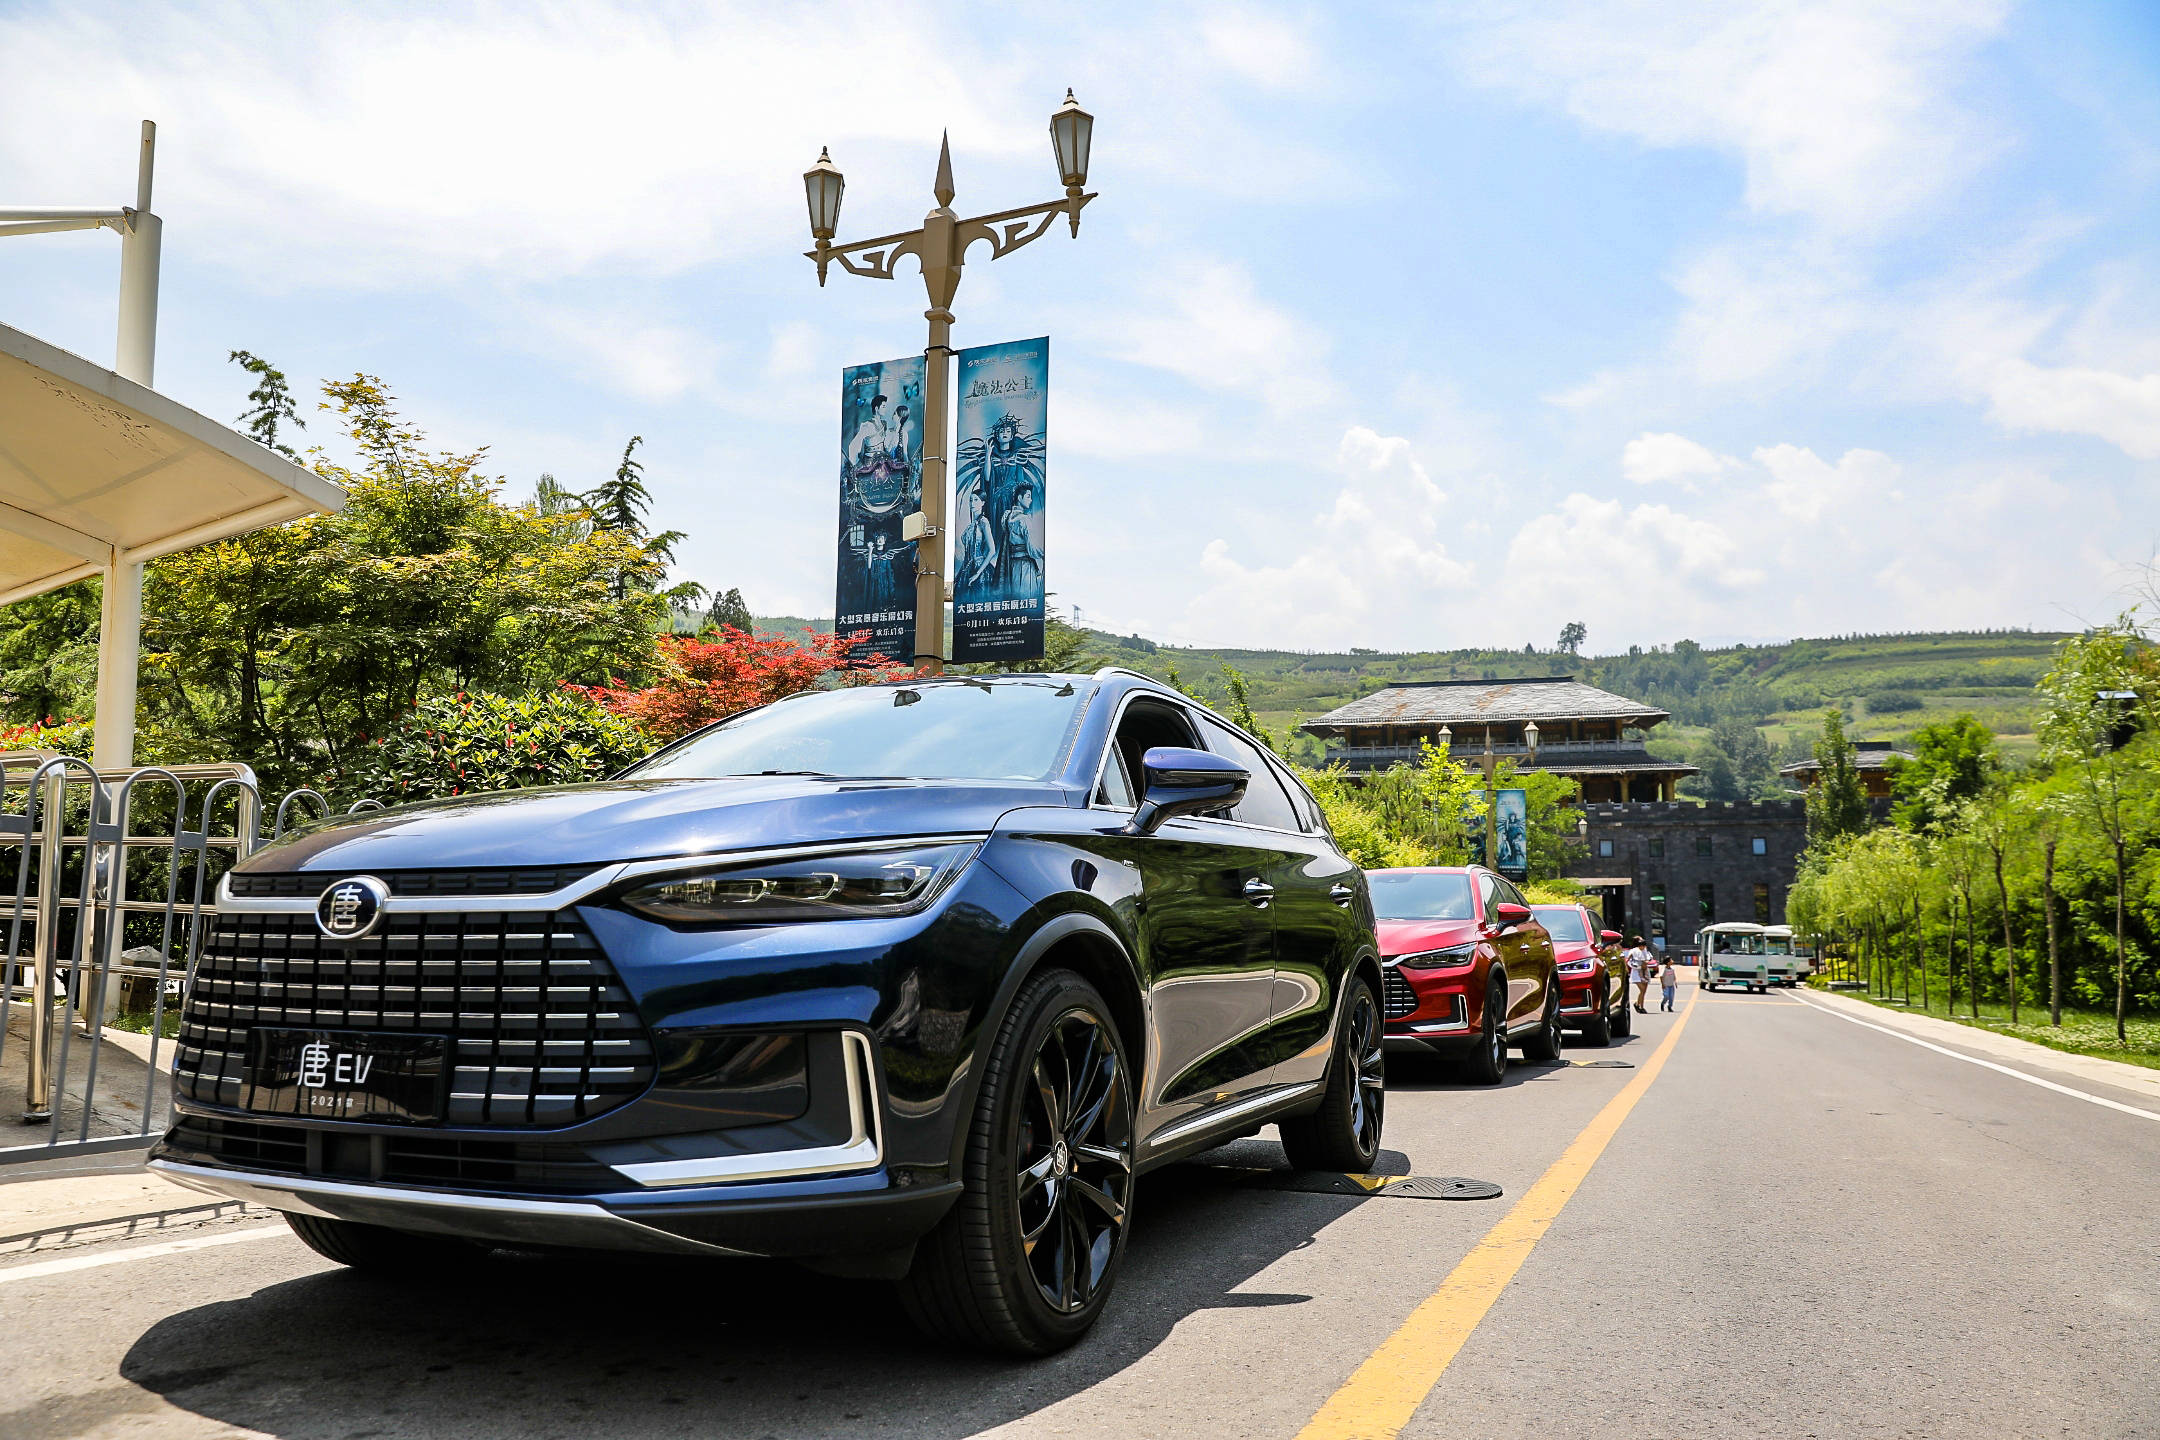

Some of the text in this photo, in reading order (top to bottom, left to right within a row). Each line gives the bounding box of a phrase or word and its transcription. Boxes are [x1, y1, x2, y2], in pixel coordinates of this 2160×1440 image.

[957, 598, 1038, 614] 大型实景音乐魔幻秀
[838, 610, 913, 625] 大型实景音乐魔幻秀
[328, 885, 363, 929] 唐
